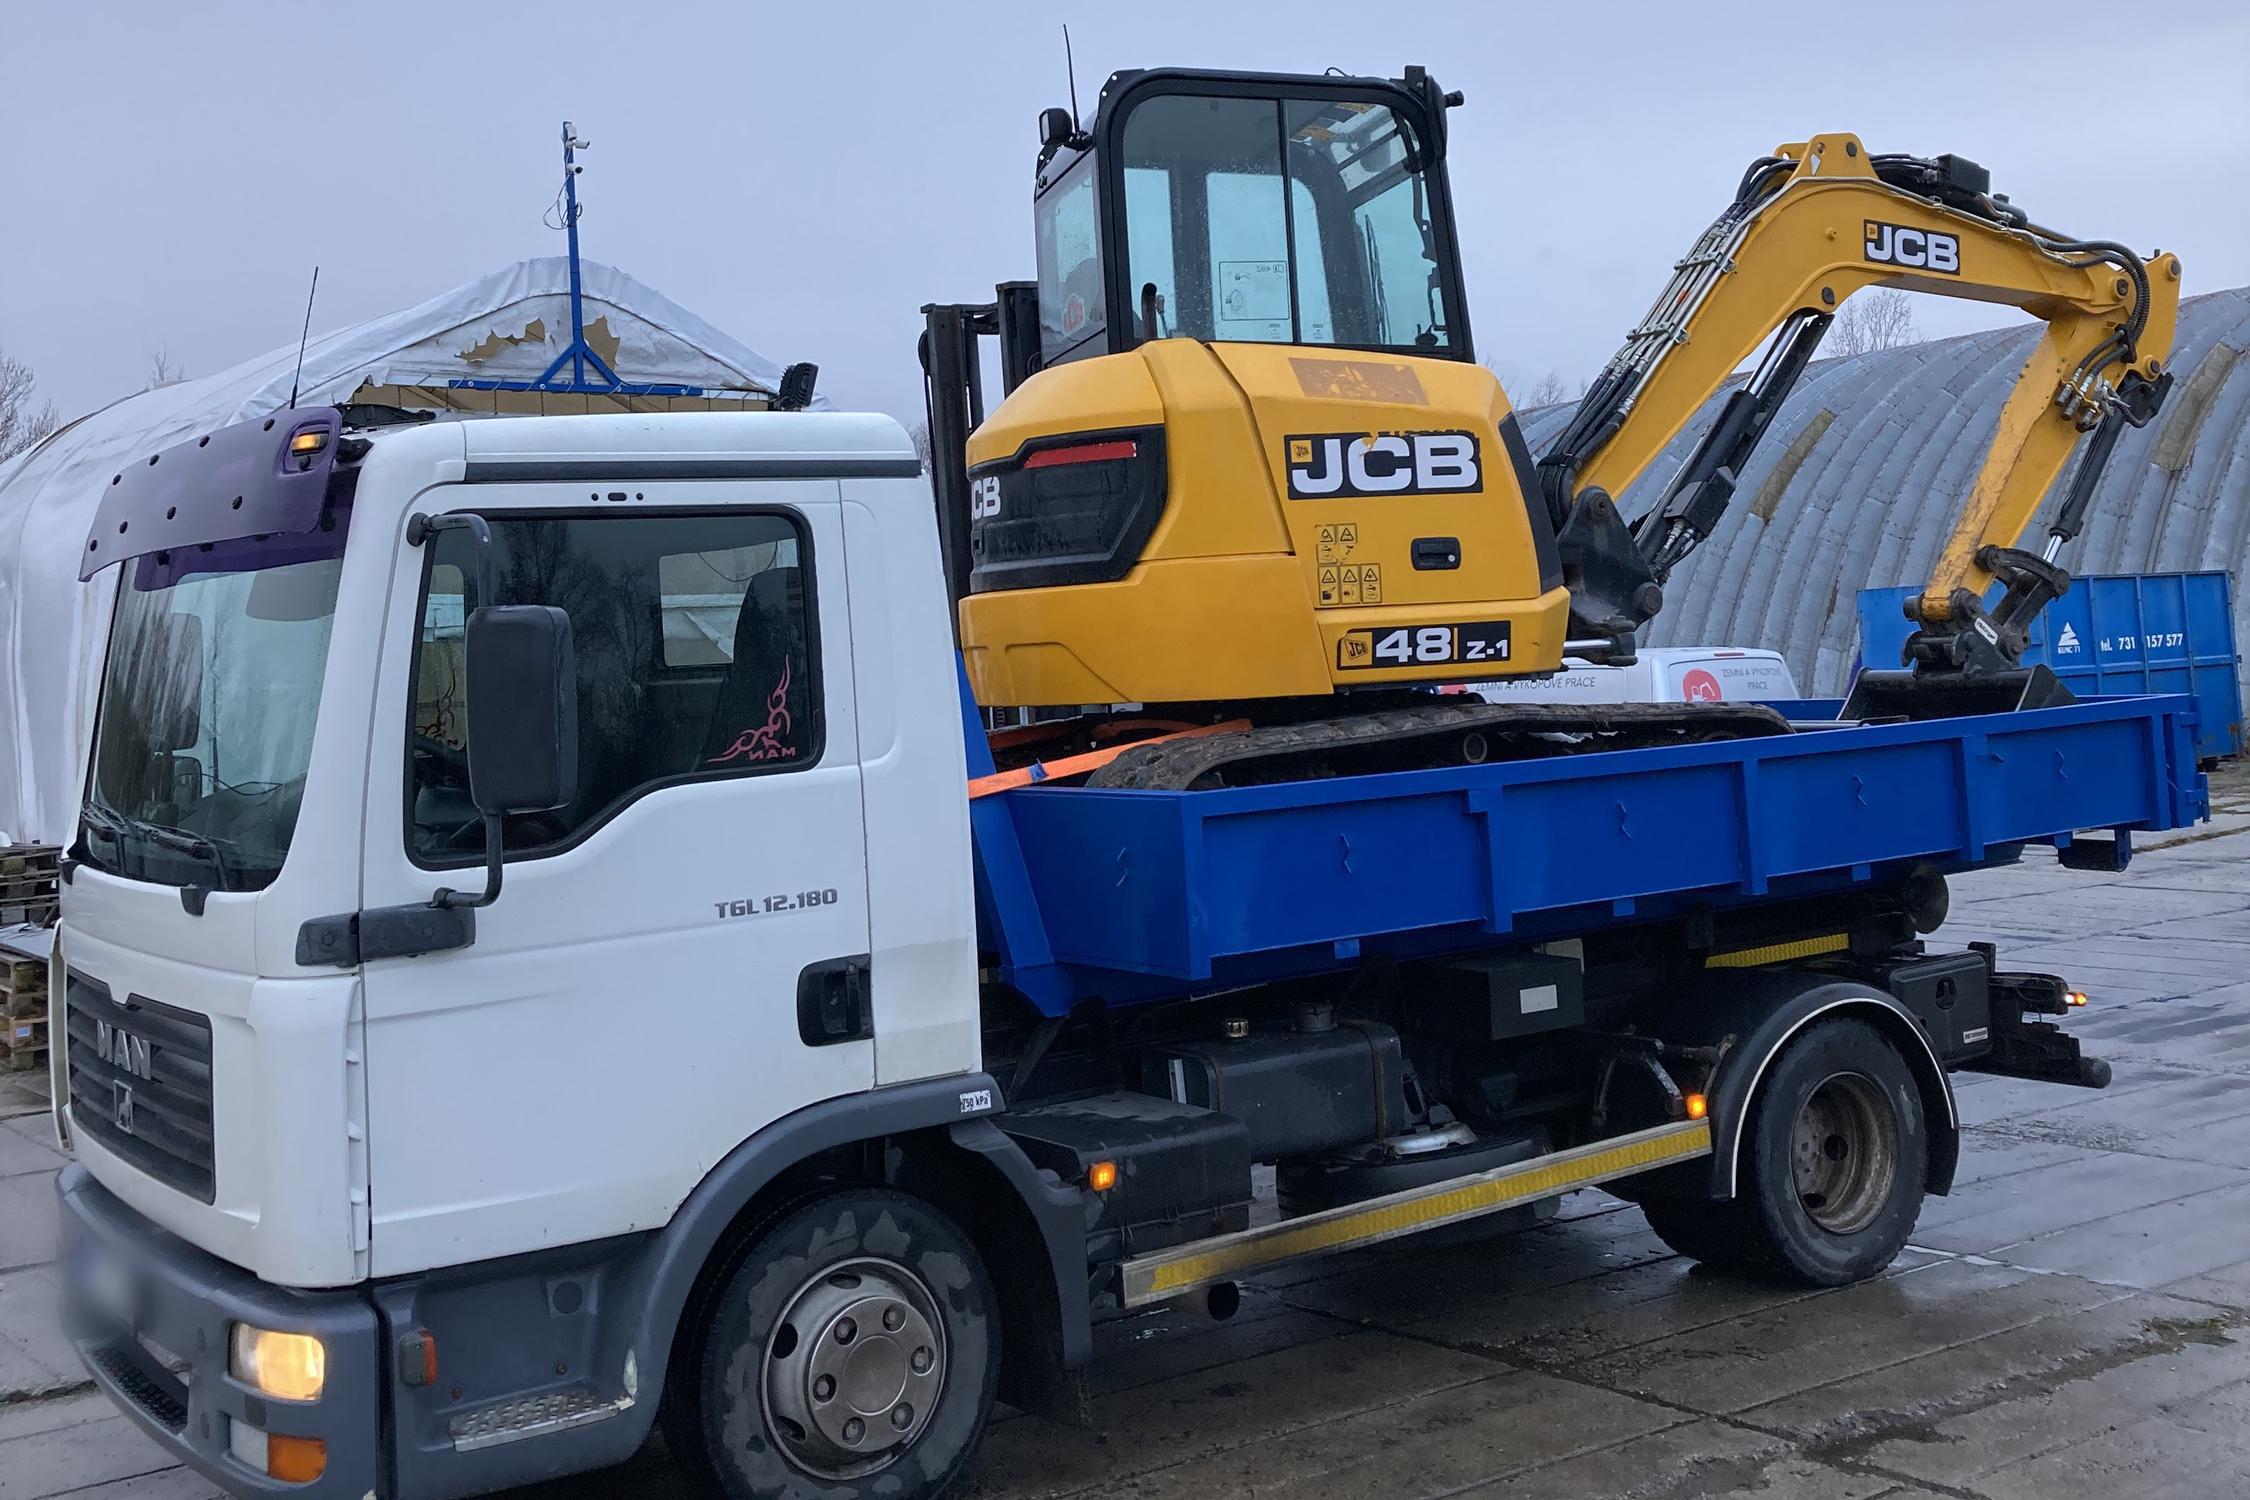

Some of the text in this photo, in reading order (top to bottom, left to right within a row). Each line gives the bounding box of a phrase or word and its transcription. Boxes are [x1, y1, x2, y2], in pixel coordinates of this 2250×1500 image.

[1866, 225, 1959, 271] JCB
[1292, 435, 1478, 493] JCB
[972, 476, 1001, 520] CB
[1349, 641, 1367, 657] JCB
[1376, 627, 1452, 663] 48
[2101, 633, 2184, 651] tel. 731 157 577
[714, 888, 839, 919] TGL 12.180
